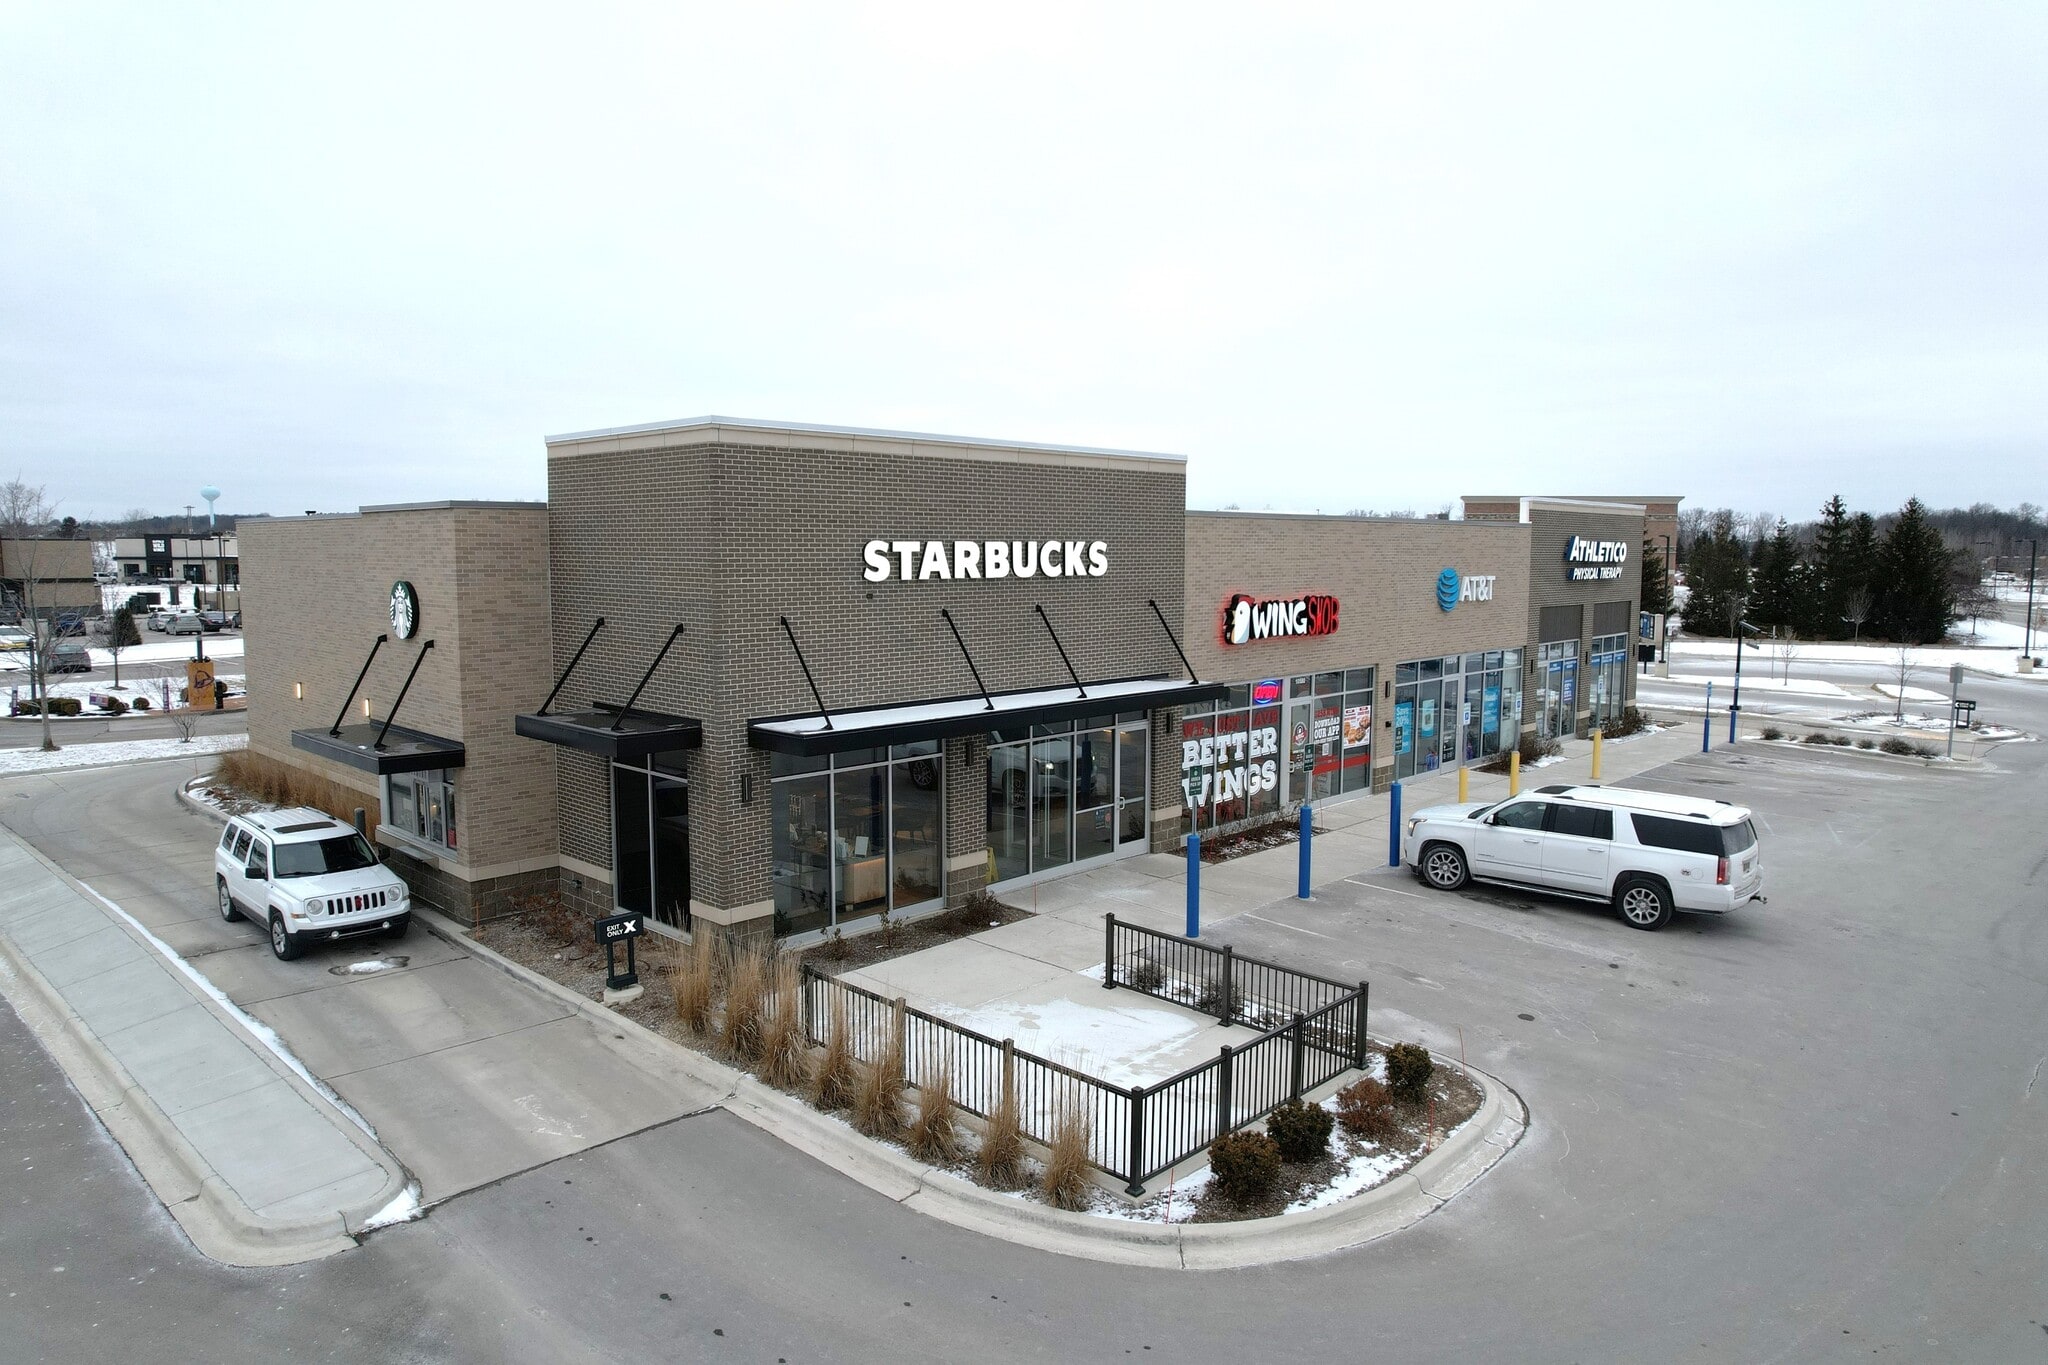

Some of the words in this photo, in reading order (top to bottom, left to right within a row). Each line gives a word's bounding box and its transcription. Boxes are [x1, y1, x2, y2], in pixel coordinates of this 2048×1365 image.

[1569, 536, 1627, 562] ATHLETICO
[863, 540, 1108, 582] STARBUCKS
[1572, 568, 1599, 580] PHYSICAL
[1600, 566, 1624, 579] THERAPY
[1461, 575, 1496, 602] AT&T
[1253, 685, 1279, 699] OPEN
[1314, 716, 1340, 729] DOWNLOAD
[1314, 728, 1327, 740] OUR
[1327, 725, 1340, 737] APP
[1181, 727, 1278, 770] BETTER
[1181, 759, 1278, 810] WINGS
[606, 923, 621, 932] EXIT
[606, 929, 624, 938] ONLY
